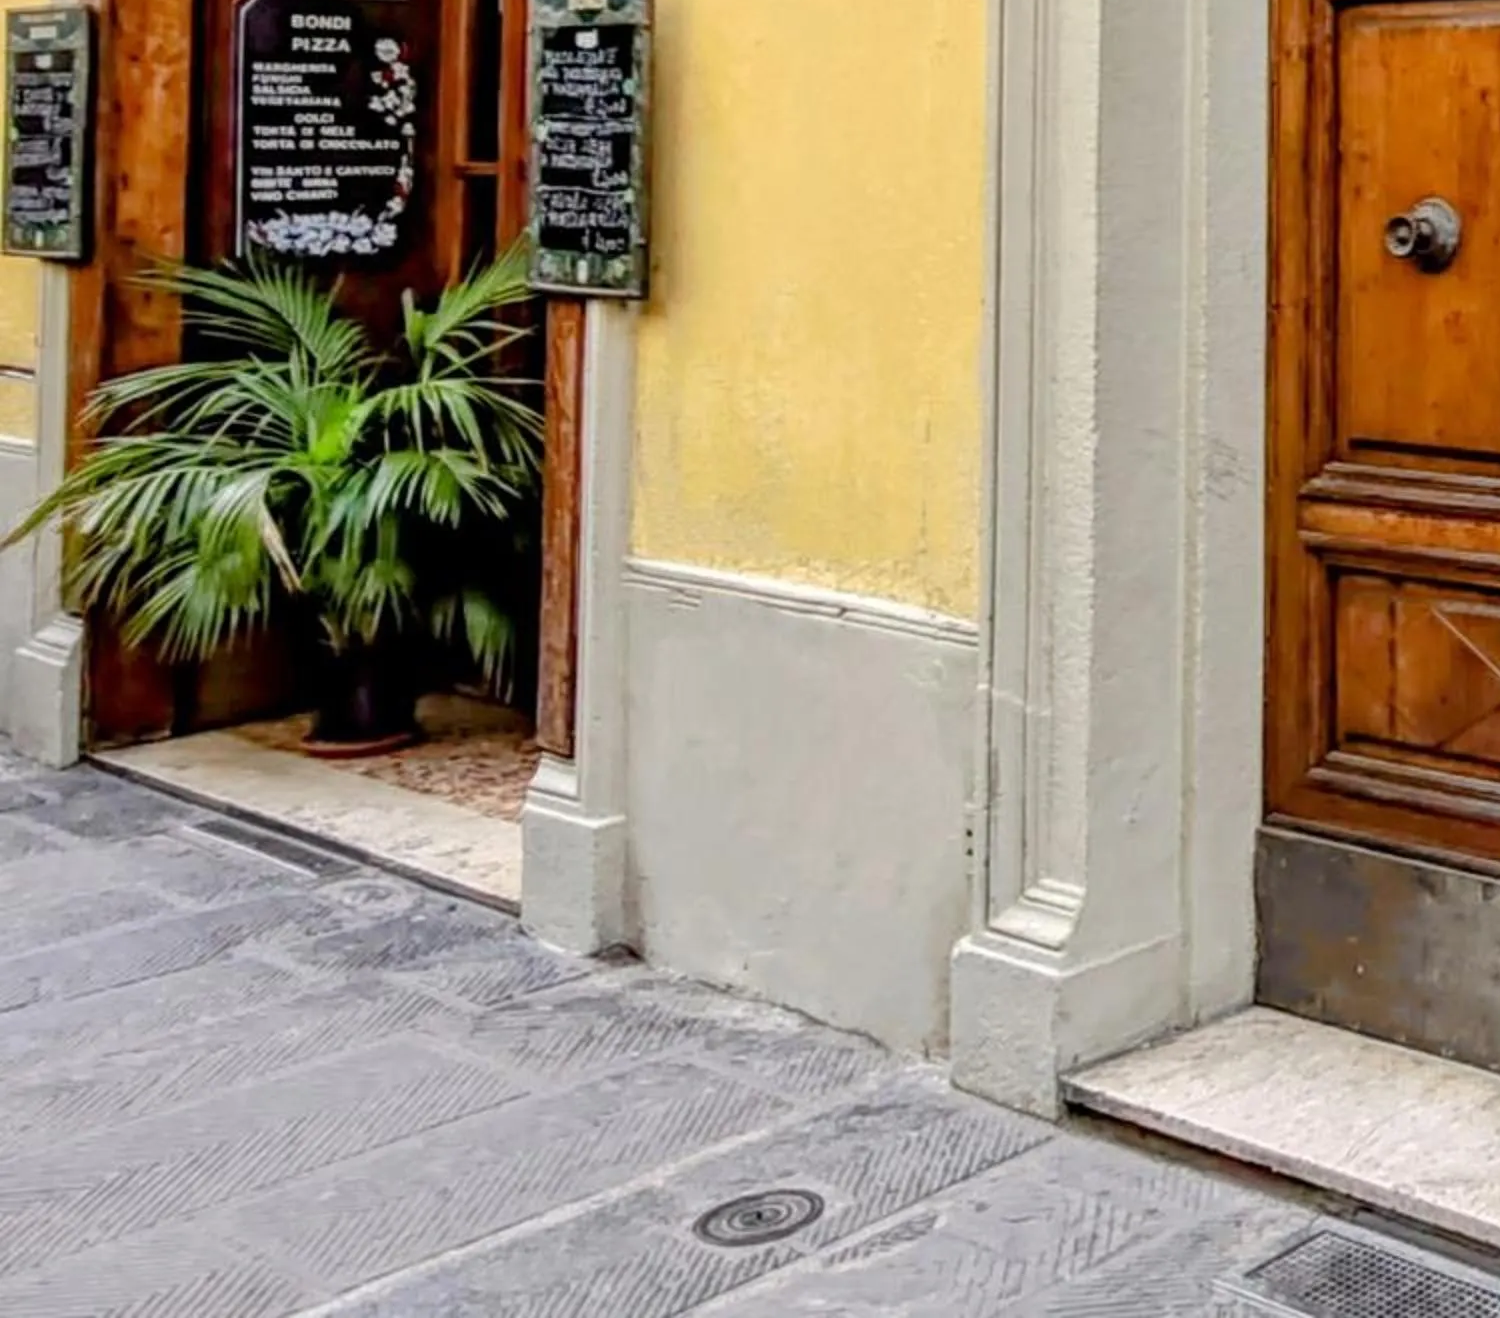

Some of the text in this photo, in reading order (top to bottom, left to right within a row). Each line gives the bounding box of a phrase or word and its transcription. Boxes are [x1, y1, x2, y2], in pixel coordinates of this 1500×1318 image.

[290, 14, 352, 30] BONDI
[291, 37, 351, 52] PIZZA
[252, 139, 297, 150] TORTA
